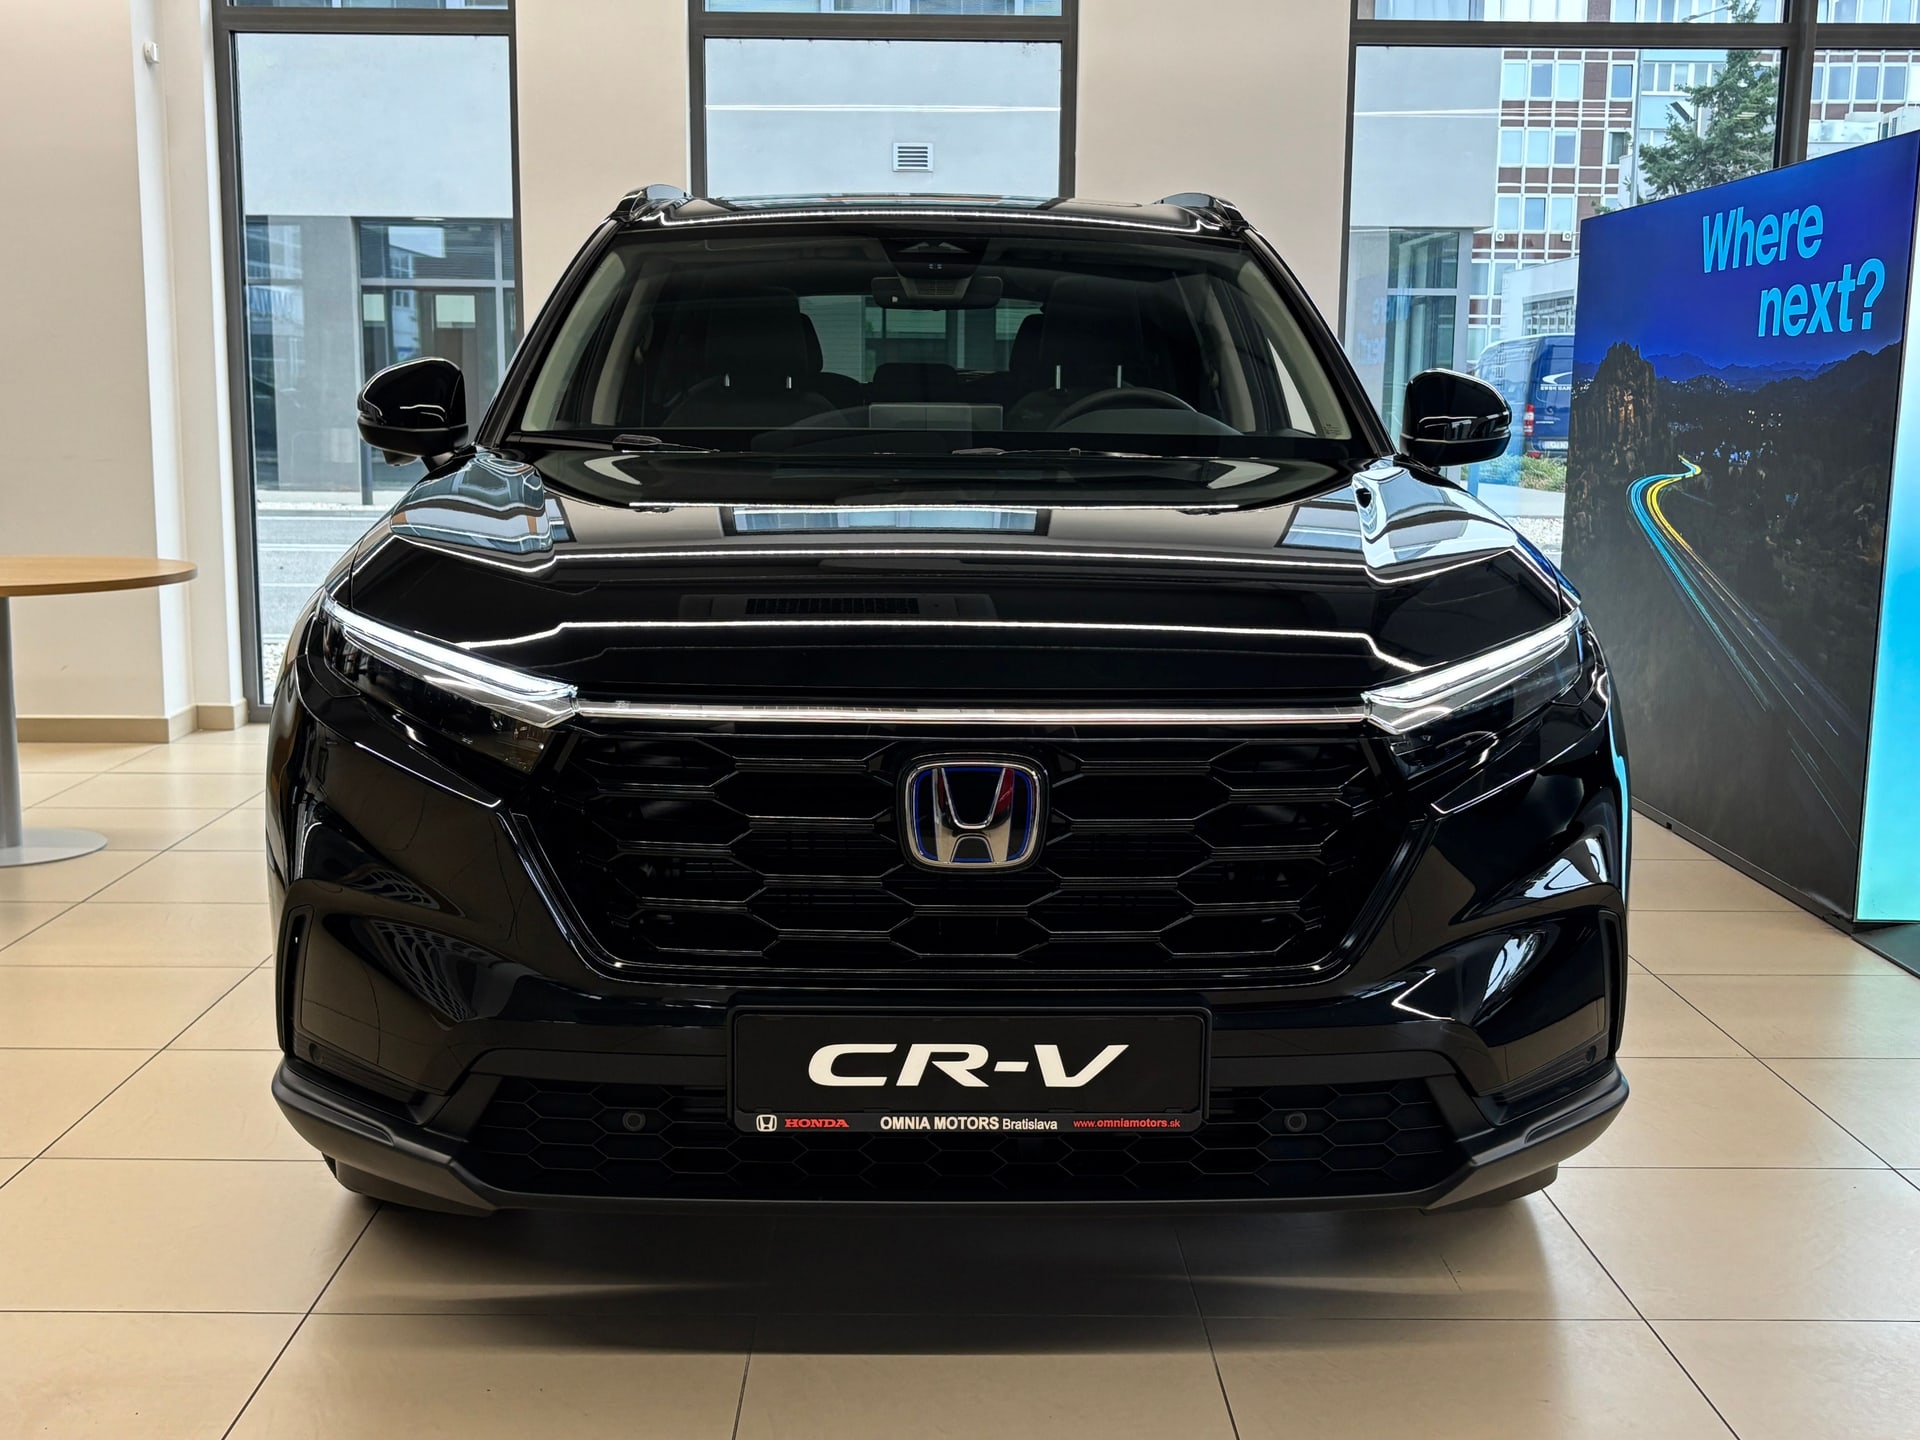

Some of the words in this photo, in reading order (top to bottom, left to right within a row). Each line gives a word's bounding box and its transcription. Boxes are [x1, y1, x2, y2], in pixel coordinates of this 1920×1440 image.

[1702, 204, 1824, 274] Where
[1757, 257, 1886, 338] next?
[808, 1043, 1130, 1088] CR-V
[784, 1118, 850, 1129] HONDA
[880, 1116, 929, 1130] OMNIA
[933, 1116, 1000, 1130] MOTORS
[1002, 1118, 1058, 1130] Bratislava
[1073, 1118, 1181, 1129] www.omniamotors.sk
